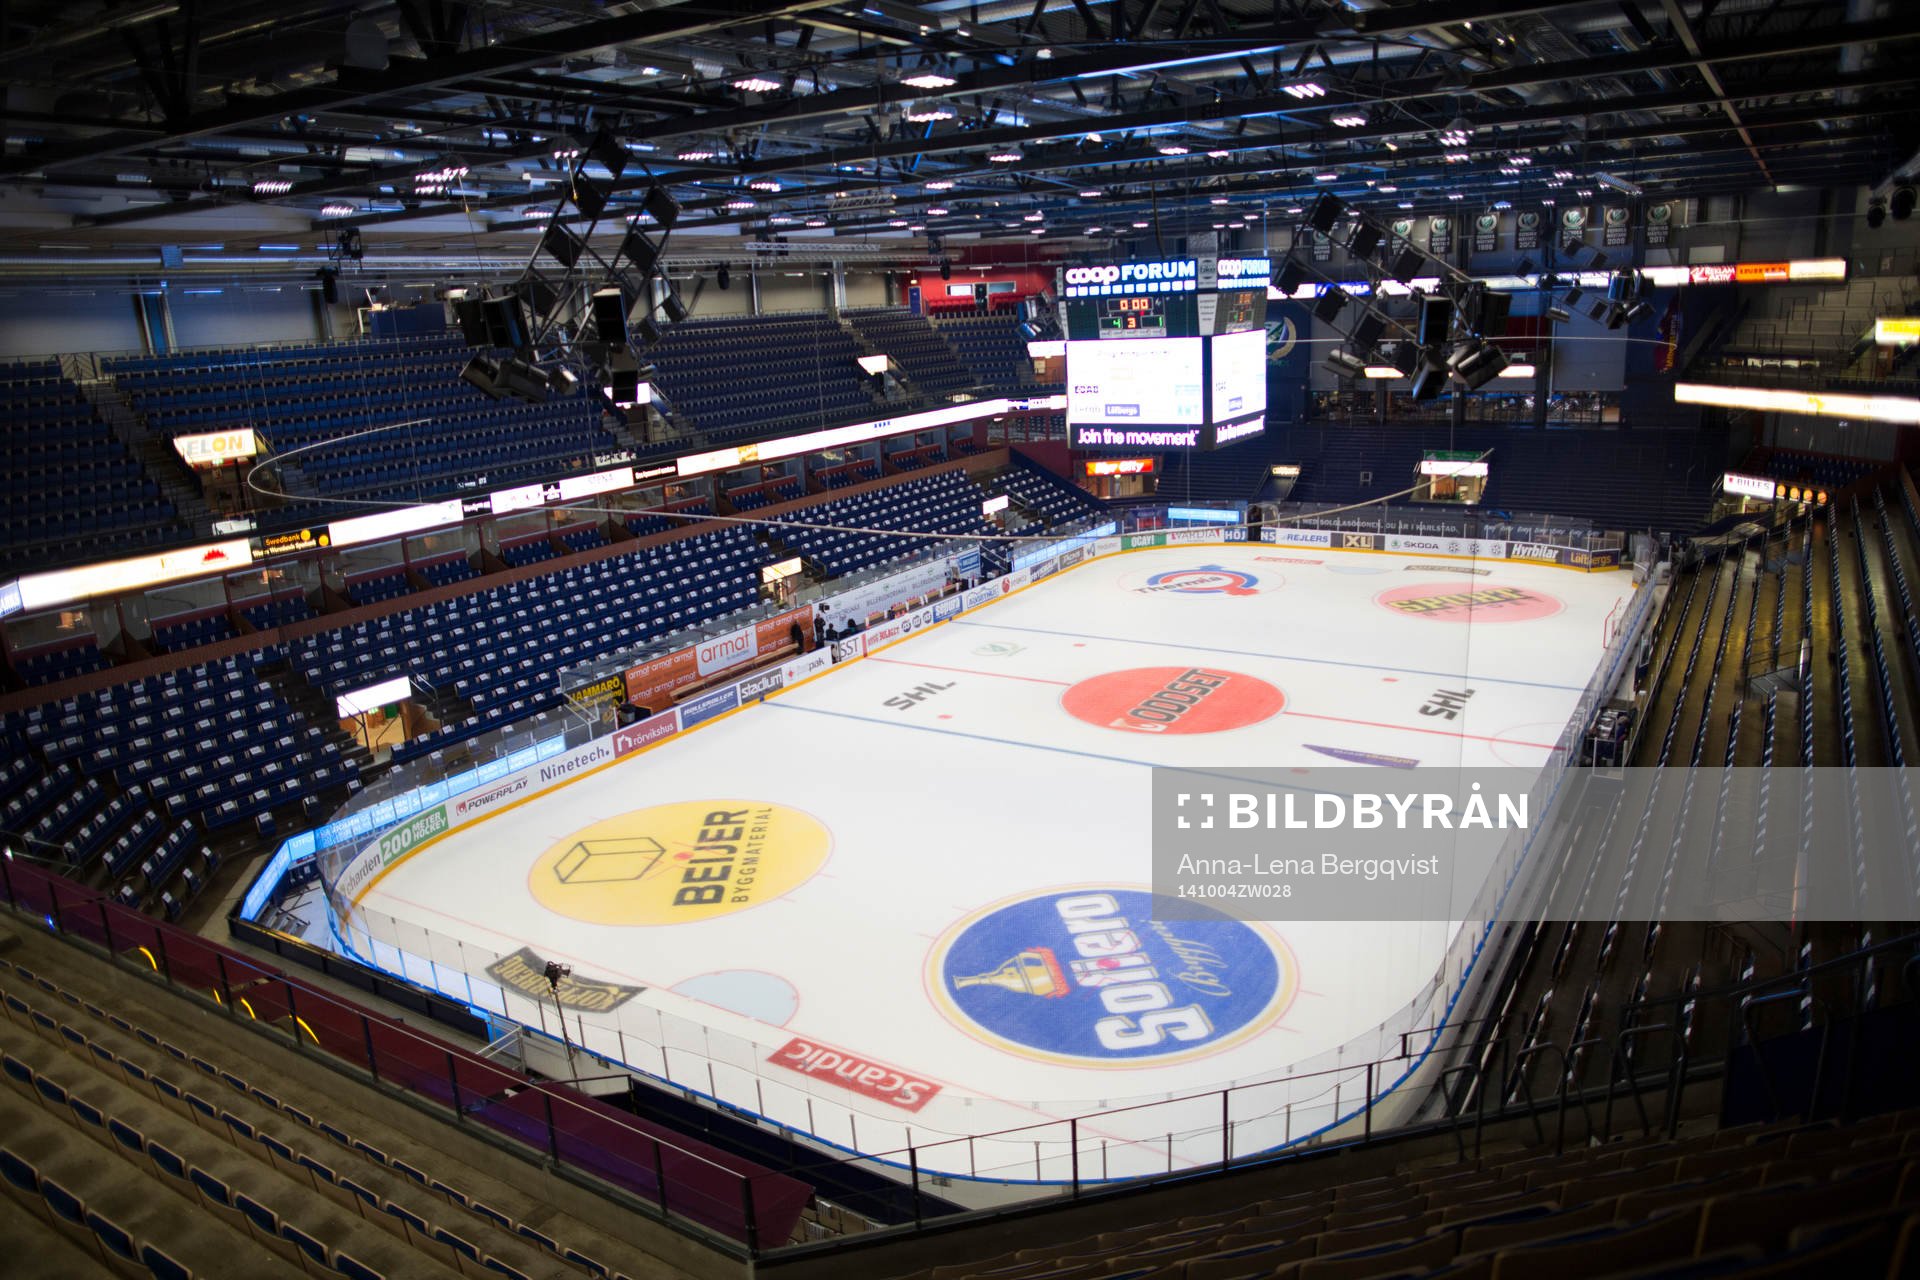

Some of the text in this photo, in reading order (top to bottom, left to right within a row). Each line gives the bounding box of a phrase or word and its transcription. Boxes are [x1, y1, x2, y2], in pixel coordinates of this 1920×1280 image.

[1065, 260, 1196, 286] coop FORUM
[1113, 318, 1121, 329] 4
[1127, 317, 1136, 329] 3
[187, 435, 243, 456] ELON
[1078, 428, 1102, 444] Join
[1102, 428, 1125, 445] the
[265, 533, 301, 547] Swedbank
[1286, 533, 1329, 543] REJLERS
[701, 631, 751, 664] armat
[628, 649, 694, 680] armat armat armat
[741, 671, 783, 699] stadium
[1418, 688, 1476, 721] SHL
[633, 722, 674, 746] rörvikshus
[467, 779, 529, 810] POWERPLAY
[411, 811, 441, 832] METER
[412, 817, 446, 842] HOCKEY
[382, 827, 412, 861] 200
[672, 808, 749, 907] BEIJER
[731, 807, 773, 904] BYGGMATERIAL
[1055, 893, 1215, 1050] Sofiero
[784, 1041, 932, 1107] Scandic
